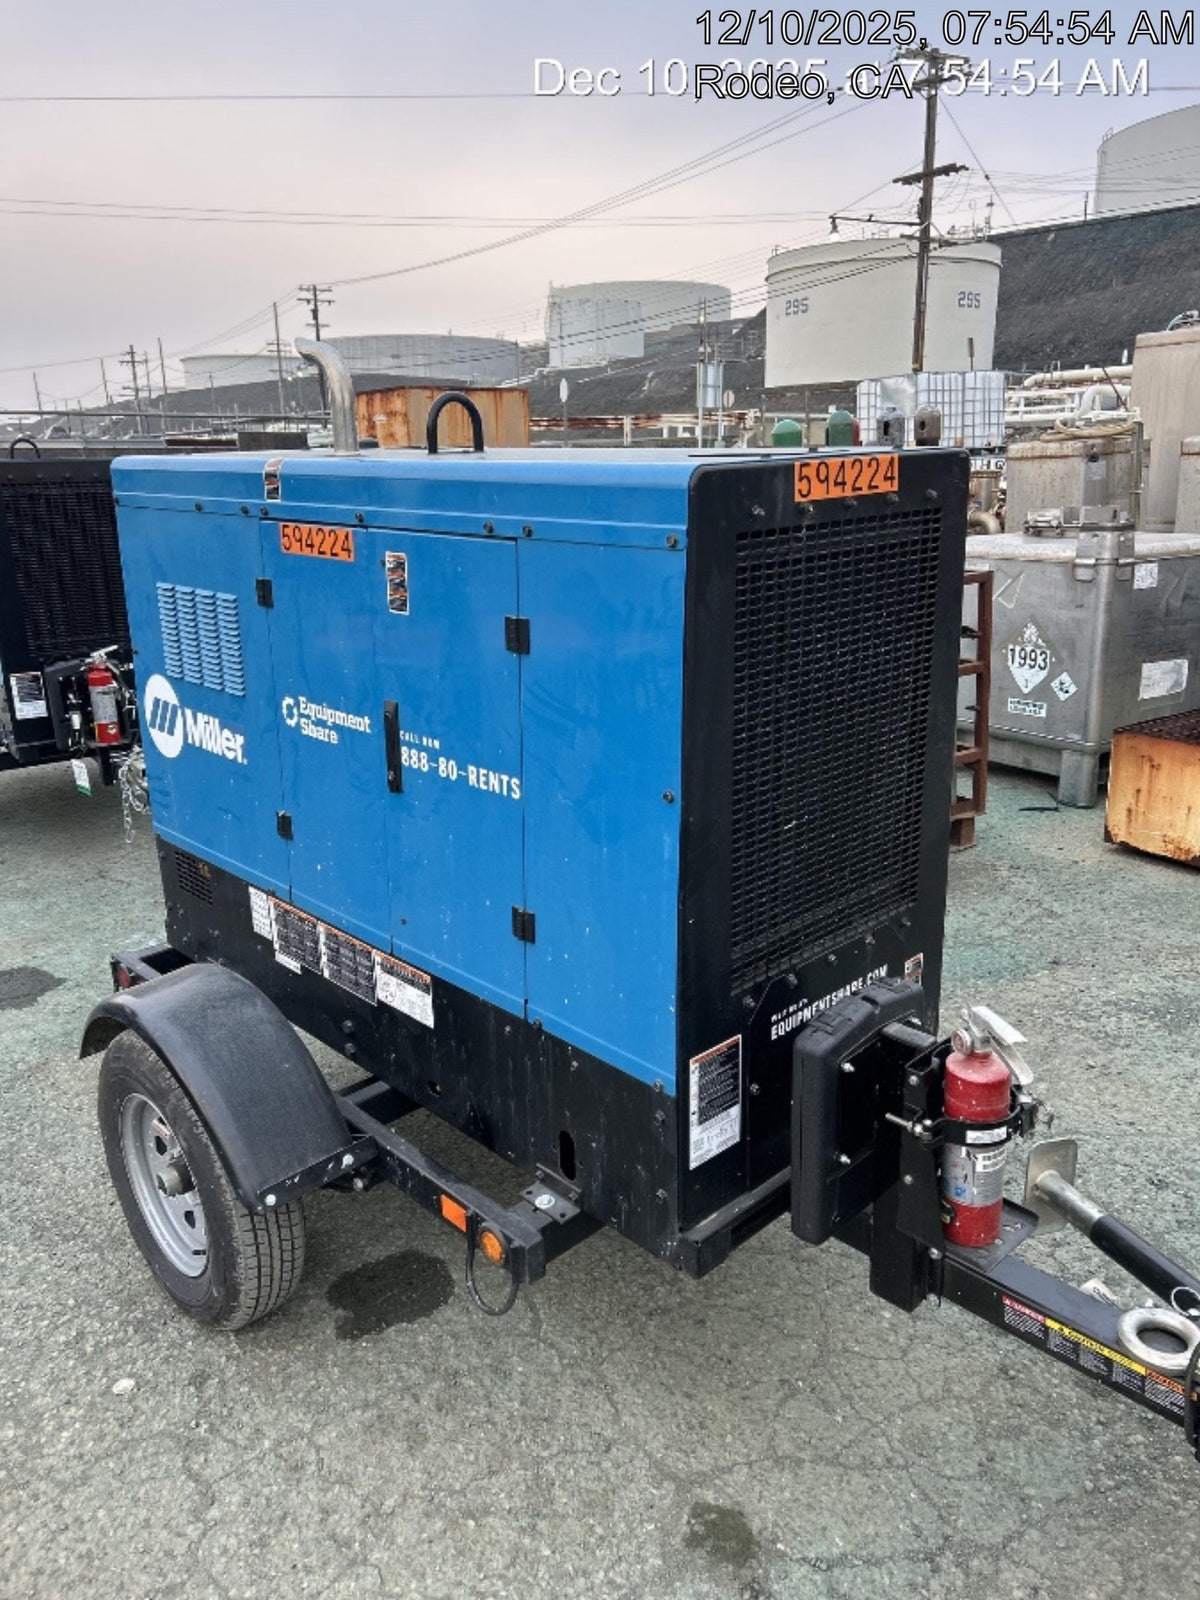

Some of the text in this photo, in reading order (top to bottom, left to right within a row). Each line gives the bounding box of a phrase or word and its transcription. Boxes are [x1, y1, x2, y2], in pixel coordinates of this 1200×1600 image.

[784, 297, 810, 317] 295
[957, 291, 981, 309] 295
[797, 455, 897, 499] 594224
[281, 523, 353, 560] 594224
[1009, 647, 1048, 671] 1993
[298, 695, 372, 733] Equipment
[300, 717, 339, 744] Share
[184, 706, 246, 763] Miller
[400, 745, 522, 801] 888-80-RENTS
